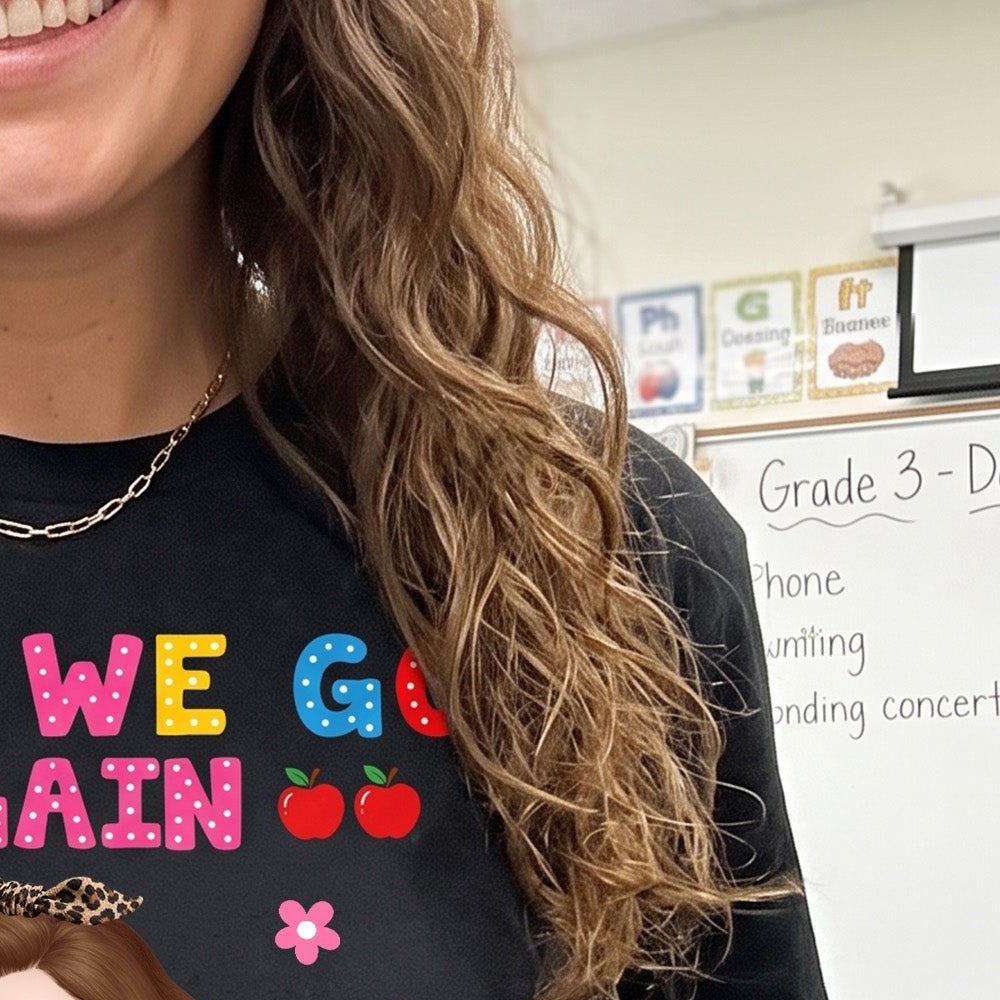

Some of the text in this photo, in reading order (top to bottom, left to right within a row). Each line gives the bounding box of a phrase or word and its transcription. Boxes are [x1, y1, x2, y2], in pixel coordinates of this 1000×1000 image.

[759, 457, 878, 512] Grade
[894, 449, 923, 500] 3
[968, 443, 1000, 494] D
[22, 633, 227, 738] WE
